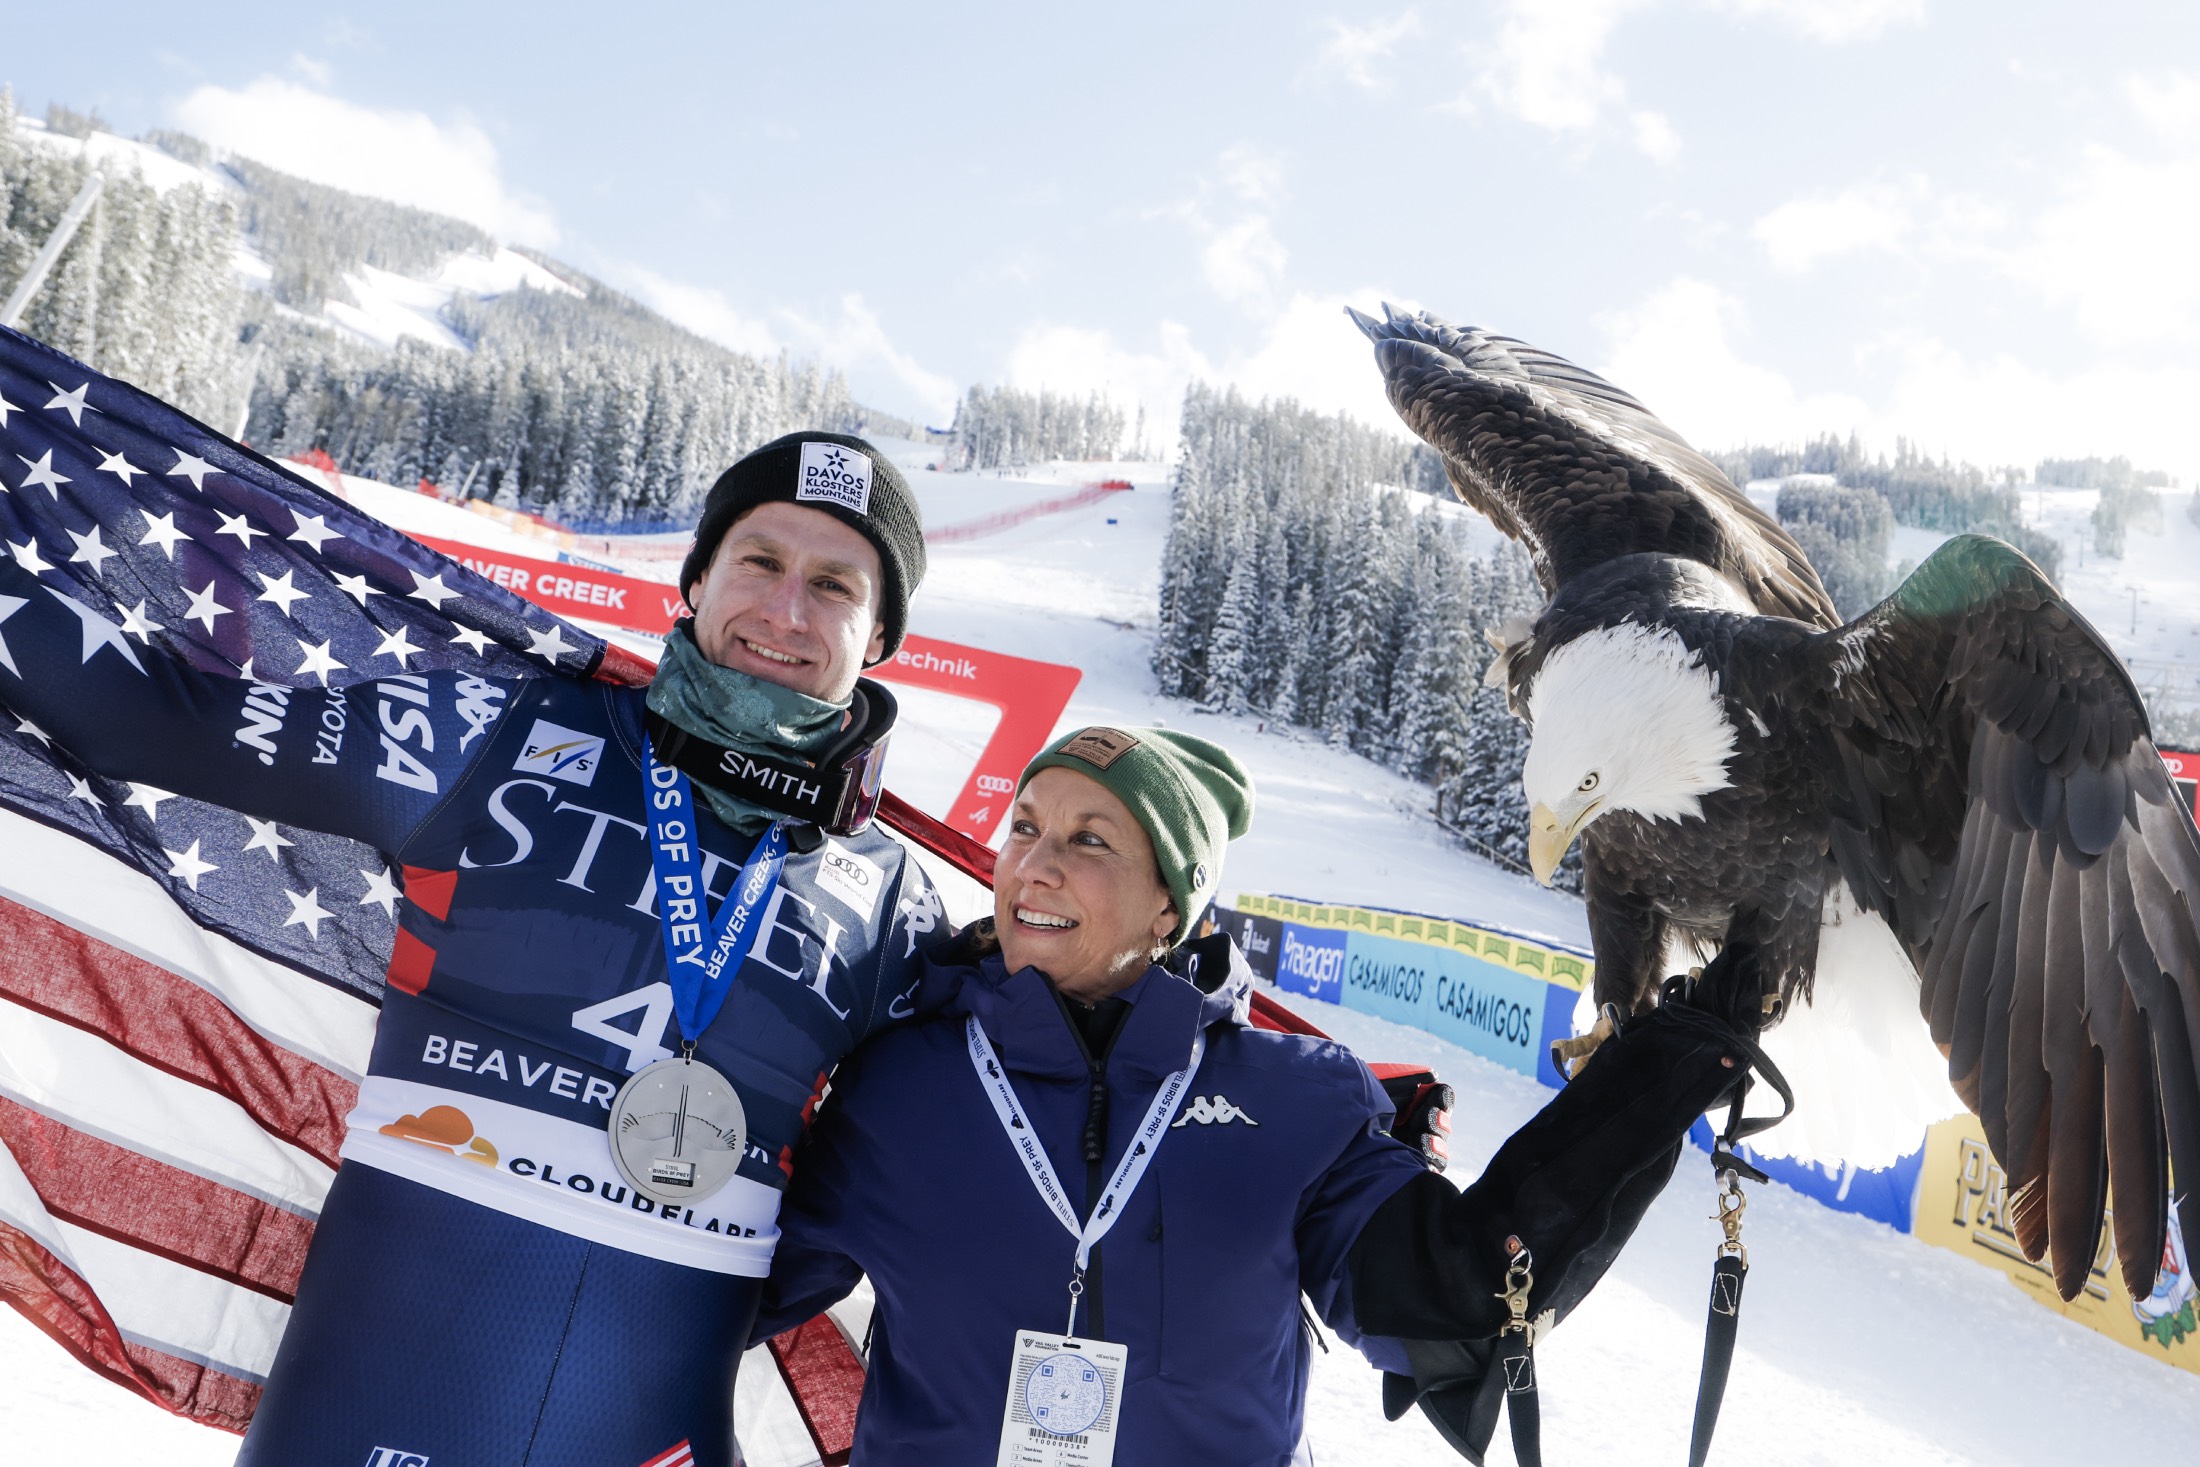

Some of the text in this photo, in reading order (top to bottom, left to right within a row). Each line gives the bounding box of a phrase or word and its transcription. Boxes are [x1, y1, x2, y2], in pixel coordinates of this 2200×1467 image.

[806, 478, 862, 500] KLOSTERS
[807, 466, 864, 490] DAVOS
[805, 488, 861, 508] MOUNTAINS
[443, 553, 530, 591] AVER
[536, 574, 628, 610] CREEK
[896, 650, 978, 680] echnik
[235, 680, 293, 766] KIN'
[524, 745, 594, 772] FIS
[719, 750, 822, 804] SMITH
[658, 820, 690, 863] OF
[664, 875, 706, 970] PREY
[705, 904, 750, 980] BEAVER
[743, 848, 777, 905] CREEK,
[1349, 955, 1425, 1004] CASAMIGOS
[1436, 975, 1532, 1048] CASAMIGOS
[572, 981, 675, 1074] 4
[422, 1034, 617, 1111] BEAVER
[998, 1084, 1016, 1114] CLOUDFLARE
[1162, 1082, 1180, 1107] BIRDS
[1145, 1116, 1164, 1140] PREY
[1019, 1136, 1038, 1160] PREY
[1038, 1170, 1057, 1202] BIRDS
[1115, 1156, 1136, 1189] CLOUDFLARE
[1056, 1200, 1074, 1227] STIFEL
